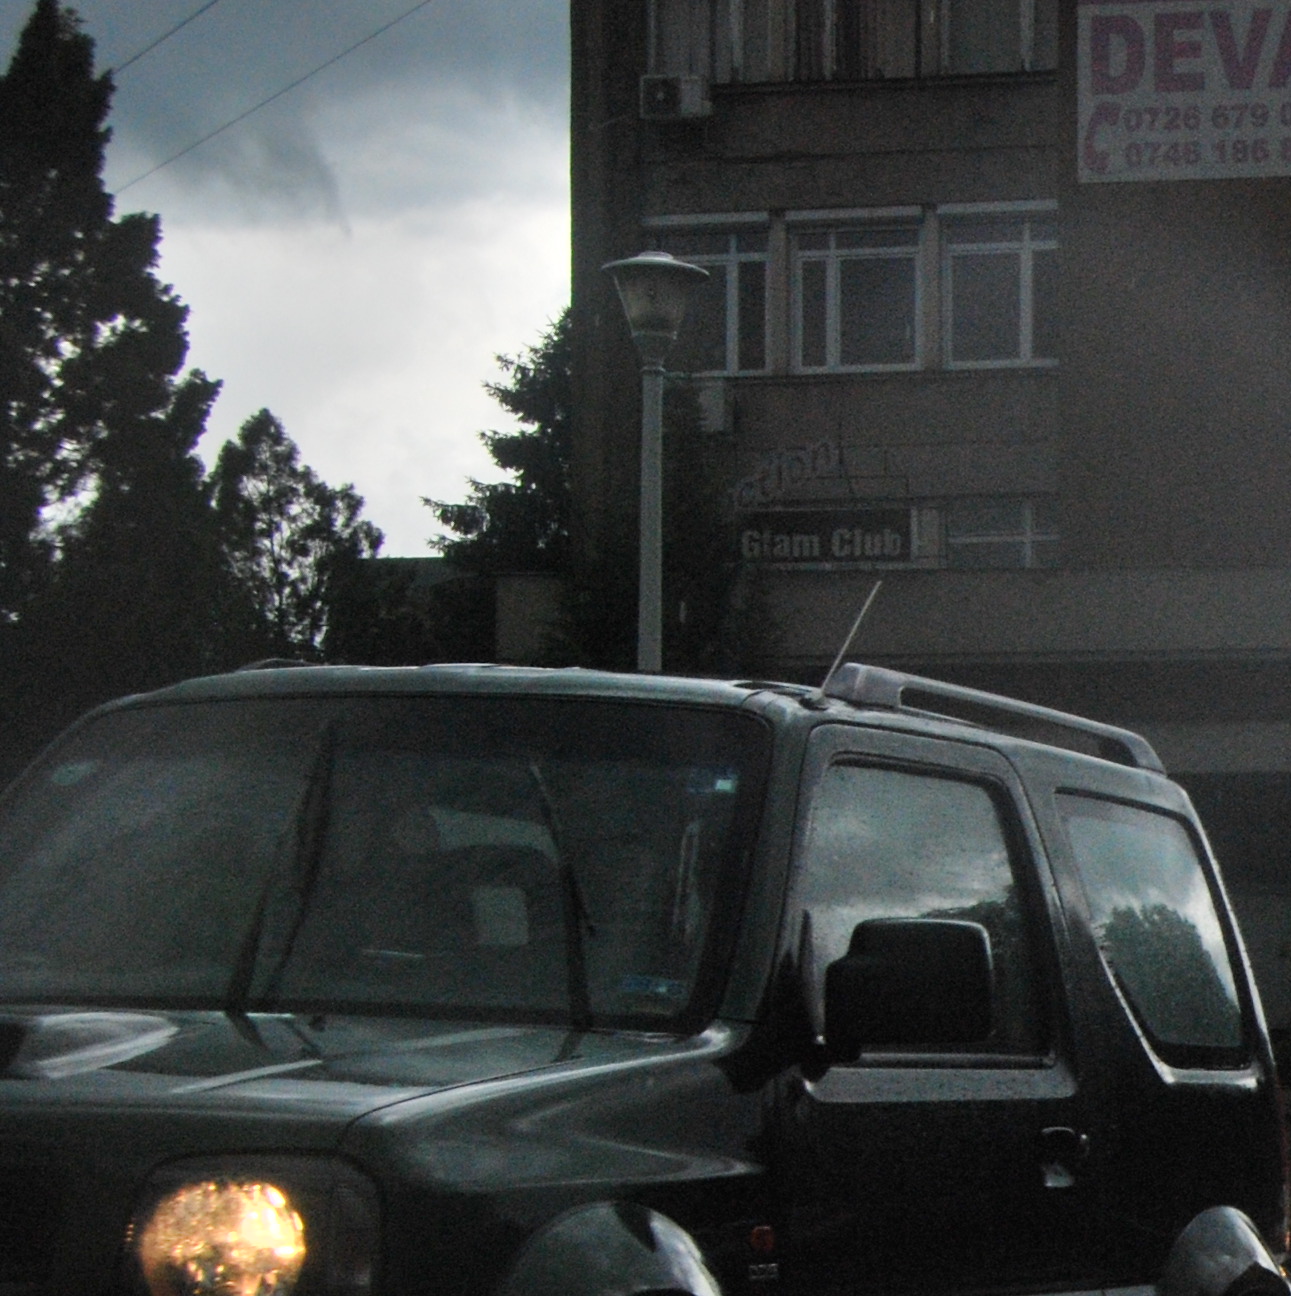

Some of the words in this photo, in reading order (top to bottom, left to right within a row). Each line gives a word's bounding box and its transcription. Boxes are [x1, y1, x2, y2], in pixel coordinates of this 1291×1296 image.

[1122, 105, 1201, 132] 0726
[1211, 103, 1269, 129] 679
[740, 529, 822, 559] Glam
[831, 527, 903, 558] Club
